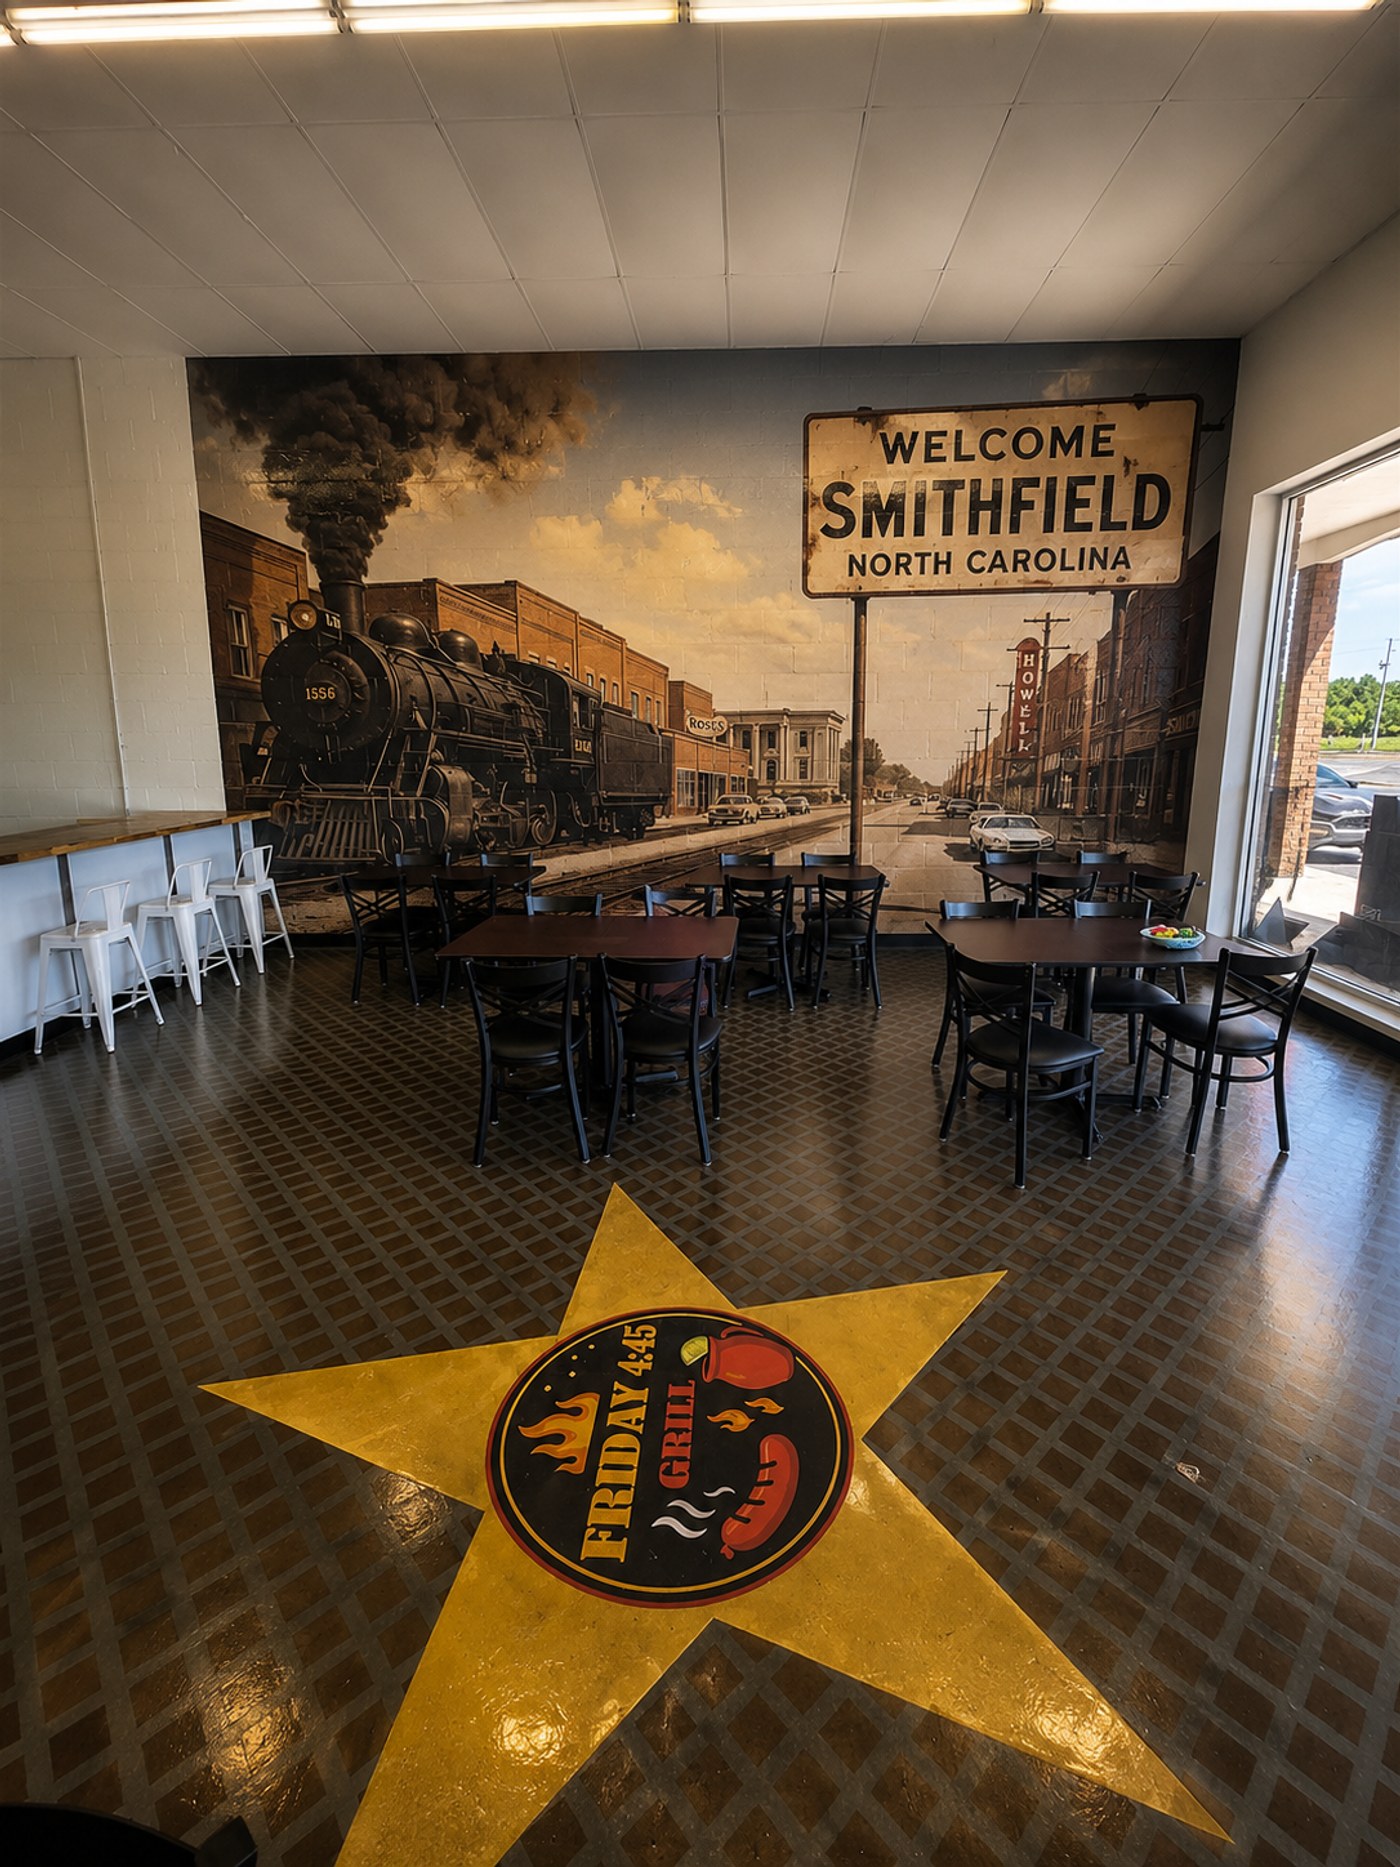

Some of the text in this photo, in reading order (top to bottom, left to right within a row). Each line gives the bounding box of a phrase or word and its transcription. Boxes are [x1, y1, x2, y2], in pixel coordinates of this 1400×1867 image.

[879, 424, 1117, 465] WELCOME
[819, 473, 1172, 539] SMITHFIELD
[848, 546, 1132, 578] NORTH CAROLINA
[580, 1323, 658, 1563] FRIDAY 4:45
[659, 1380, 695, 1489] GRILL
